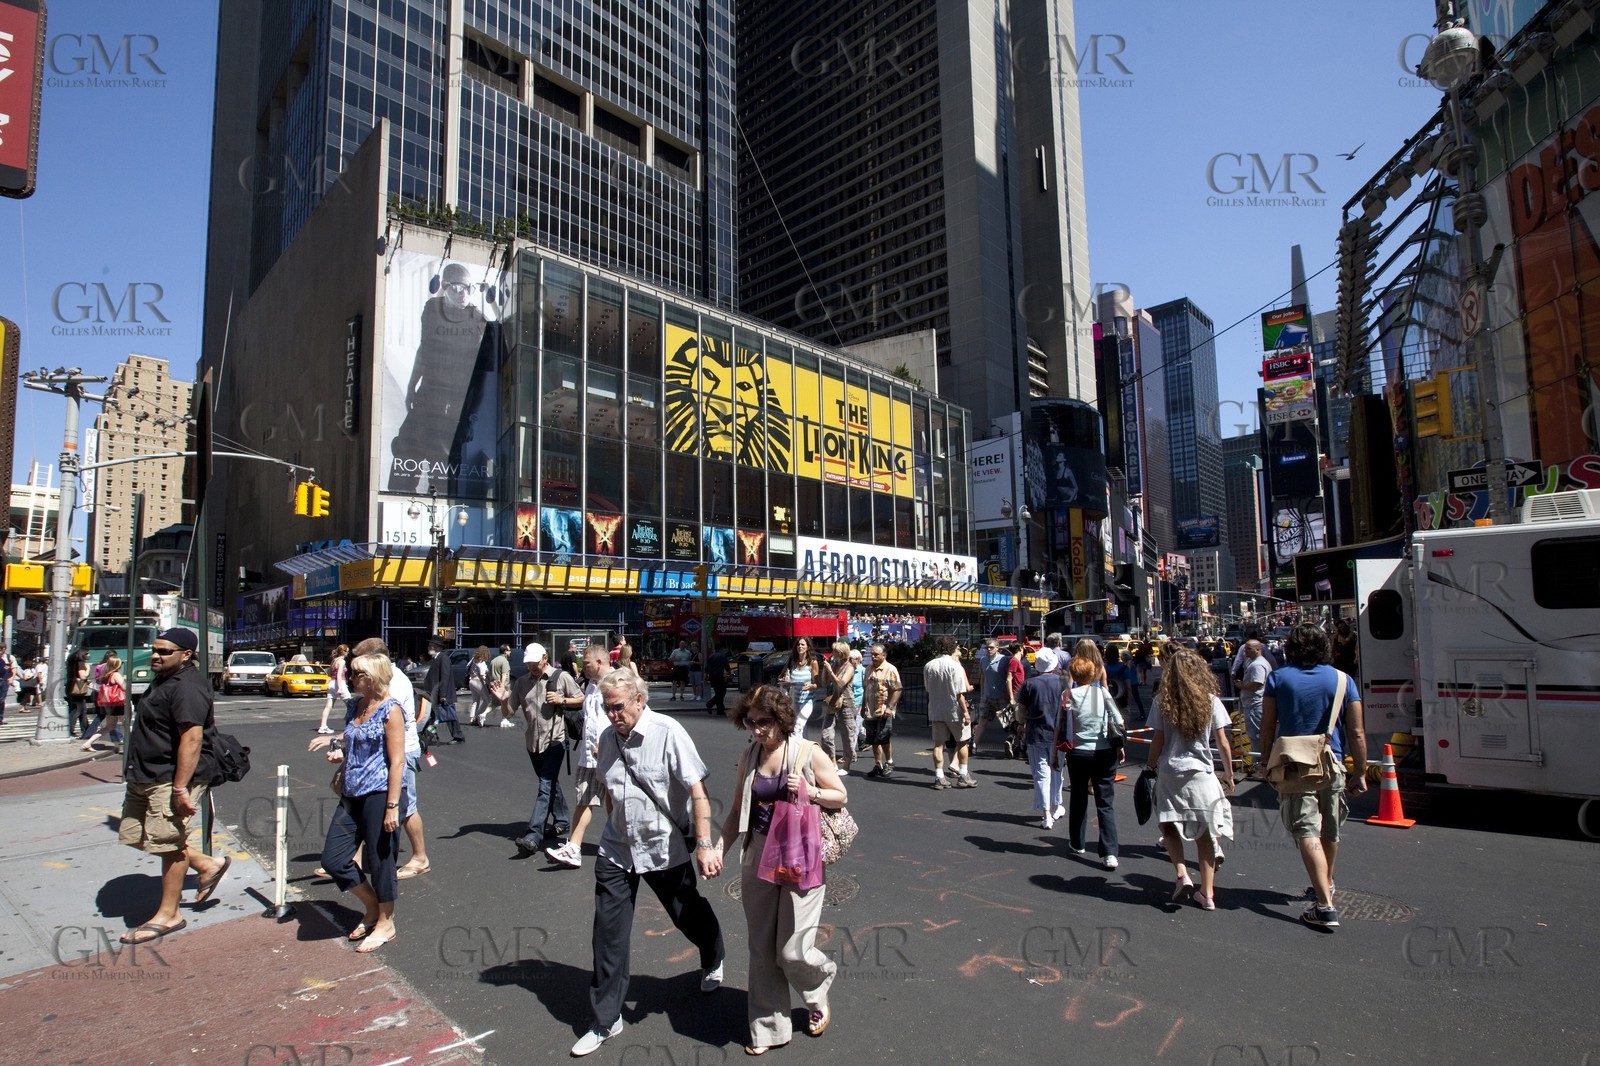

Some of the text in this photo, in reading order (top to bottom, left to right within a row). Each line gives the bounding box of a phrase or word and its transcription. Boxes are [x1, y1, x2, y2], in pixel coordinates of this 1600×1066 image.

[345, 321, 356, 429] THEATRE
[1269, 360, 1291, 370] HSBC
[836, 399, 869, 426] THE
[1269, 411, 1296, 422] HSBC
[803, 415, 907, 475] LION KING
[1126, 410, 1139, 478] SQUARE
[393, 457, 488, 478] ROCAWEAR
[826, 473, 846, 482] ENTRANCE
[1461, 474, 1487, 486] ONE
[386, 531, 417, 544] 1515
[1072, 537, 1083, 585] Kodak
